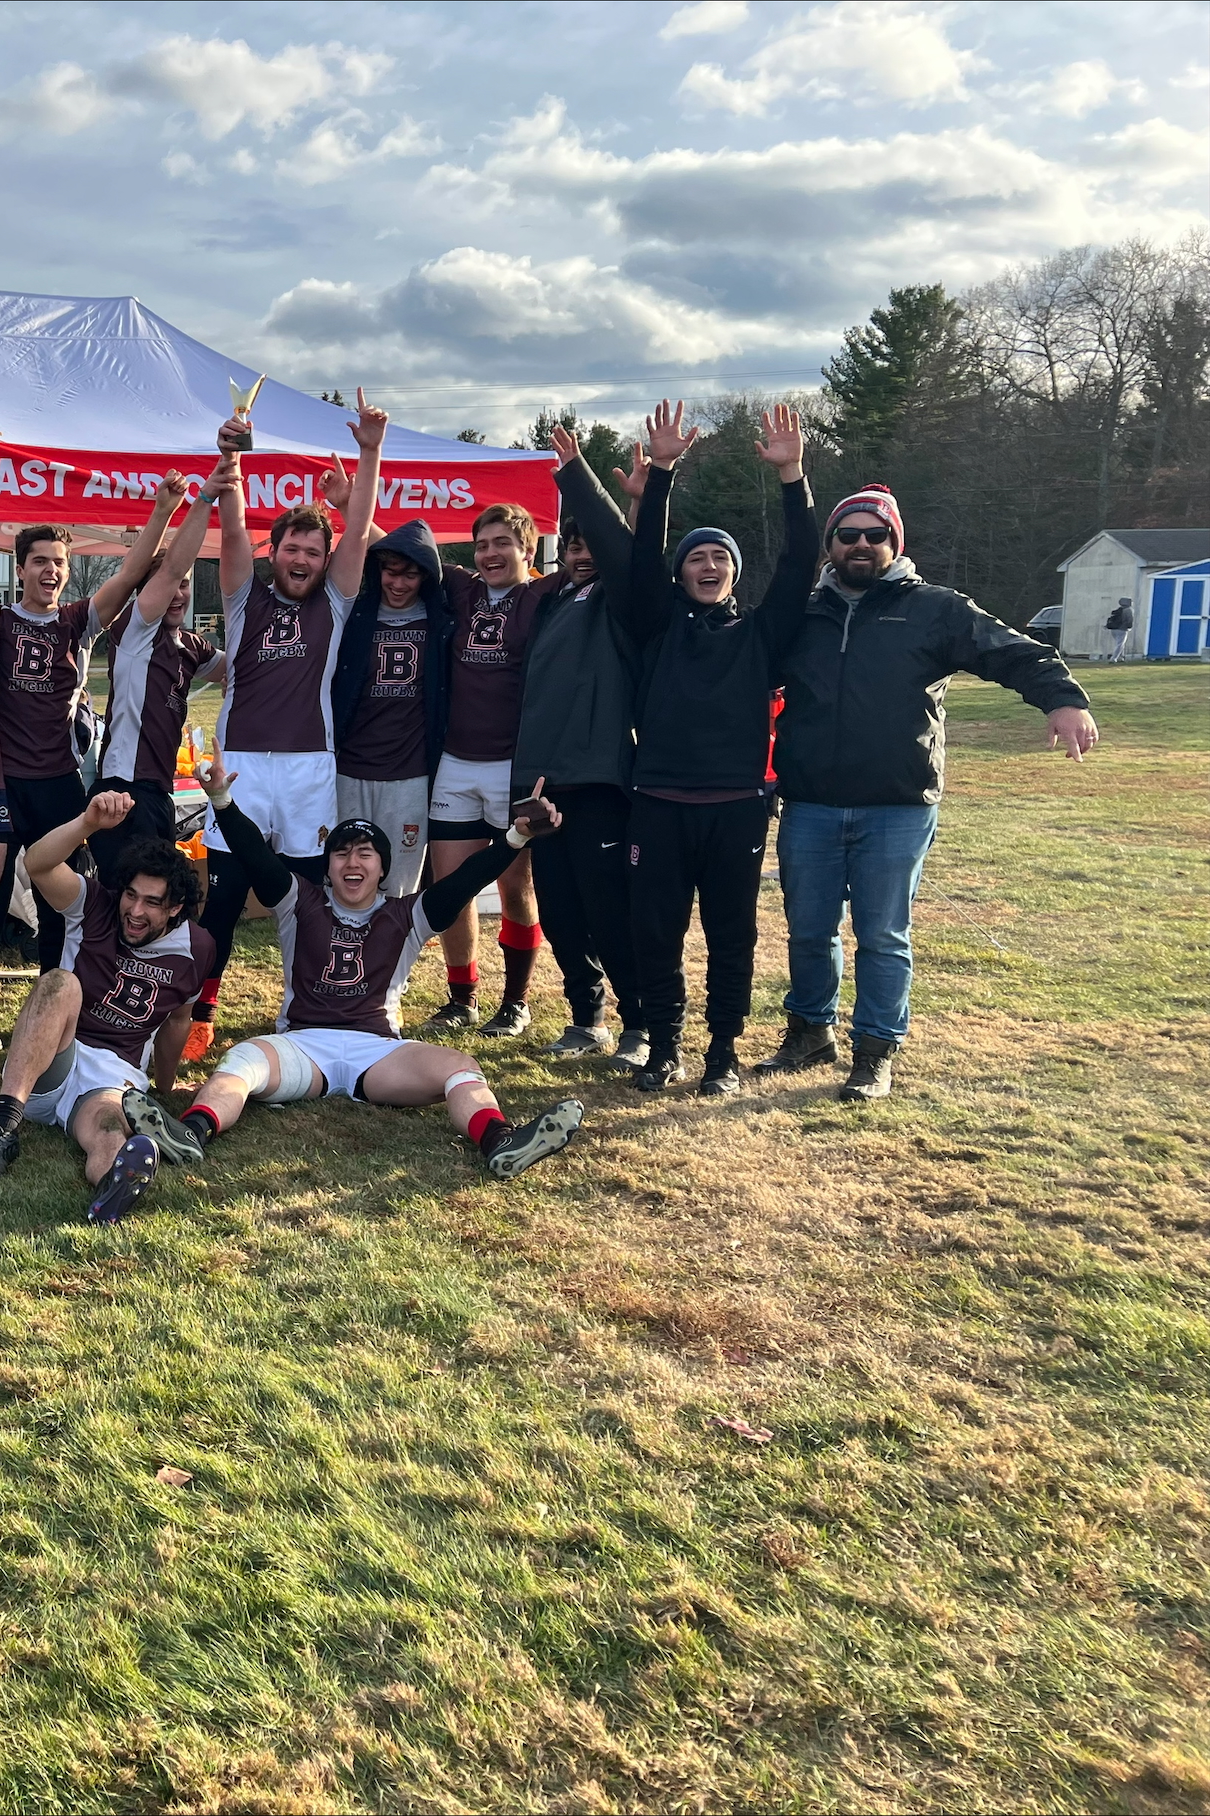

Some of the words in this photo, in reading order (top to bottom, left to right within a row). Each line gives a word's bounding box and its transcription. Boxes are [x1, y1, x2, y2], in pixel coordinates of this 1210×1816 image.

[82, 469, 166, 501] AND
[184, 473, 314, 509] CNCI
[372, 629, 427, 643] BROWN
[13, 635, 54, 681] B
[258, 643, 307, 664] RUGBY
[376, 641, 418, 685] B
[461, 649, 509, 664] RUGBY
[8, 678, 55, 693] RUGBY
[371, 685, 417, 698] RUGBY
[321, 940, 365, 986] B
[102, 969, 160, 1022] B
